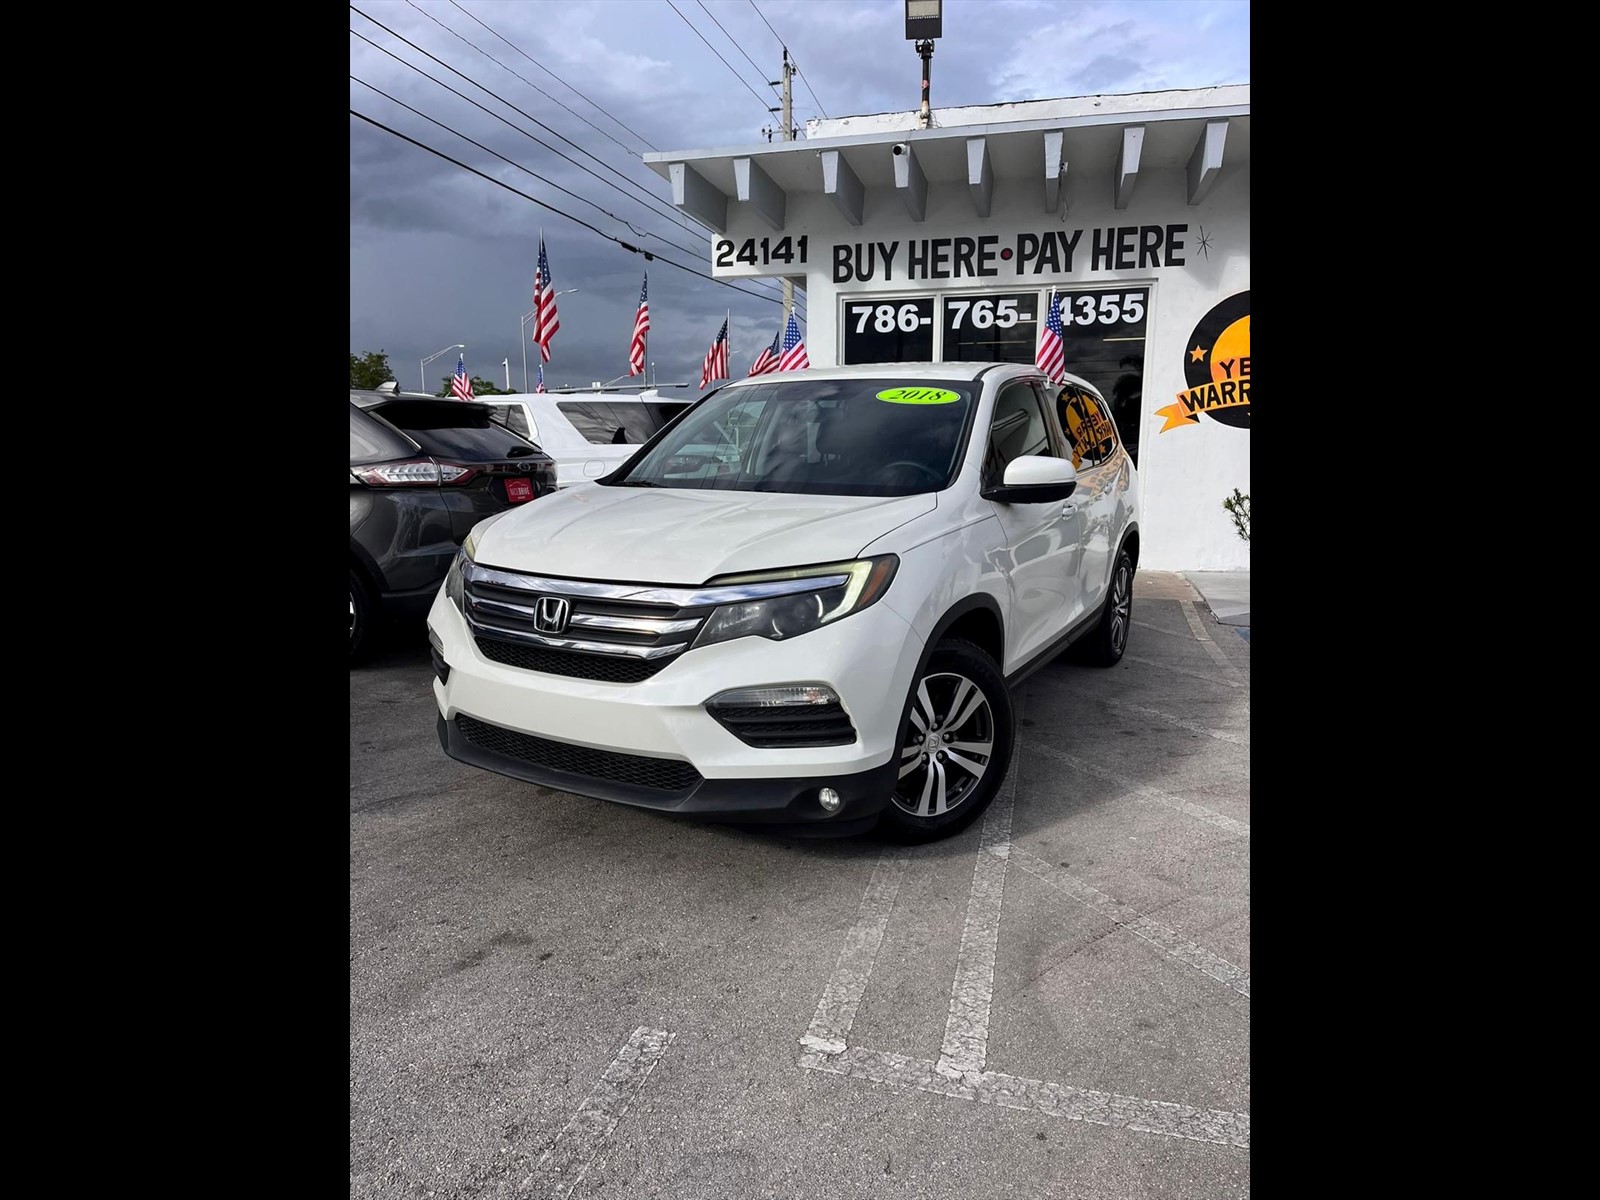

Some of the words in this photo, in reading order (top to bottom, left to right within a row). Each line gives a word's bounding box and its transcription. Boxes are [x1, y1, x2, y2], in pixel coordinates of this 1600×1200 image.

[715, 235, 808, 268] 24141
[833, 241, 899, 284] BUY
[908, 235, 999, 280] HERE
[1016, 229, 1084, 275] PAY
[1091, 223, 1189, 272] HERE
[852, 303, 932, 334] 786-
[947, 298, 1032, 330] 765-
[888, 389, 947, 401] 2018
